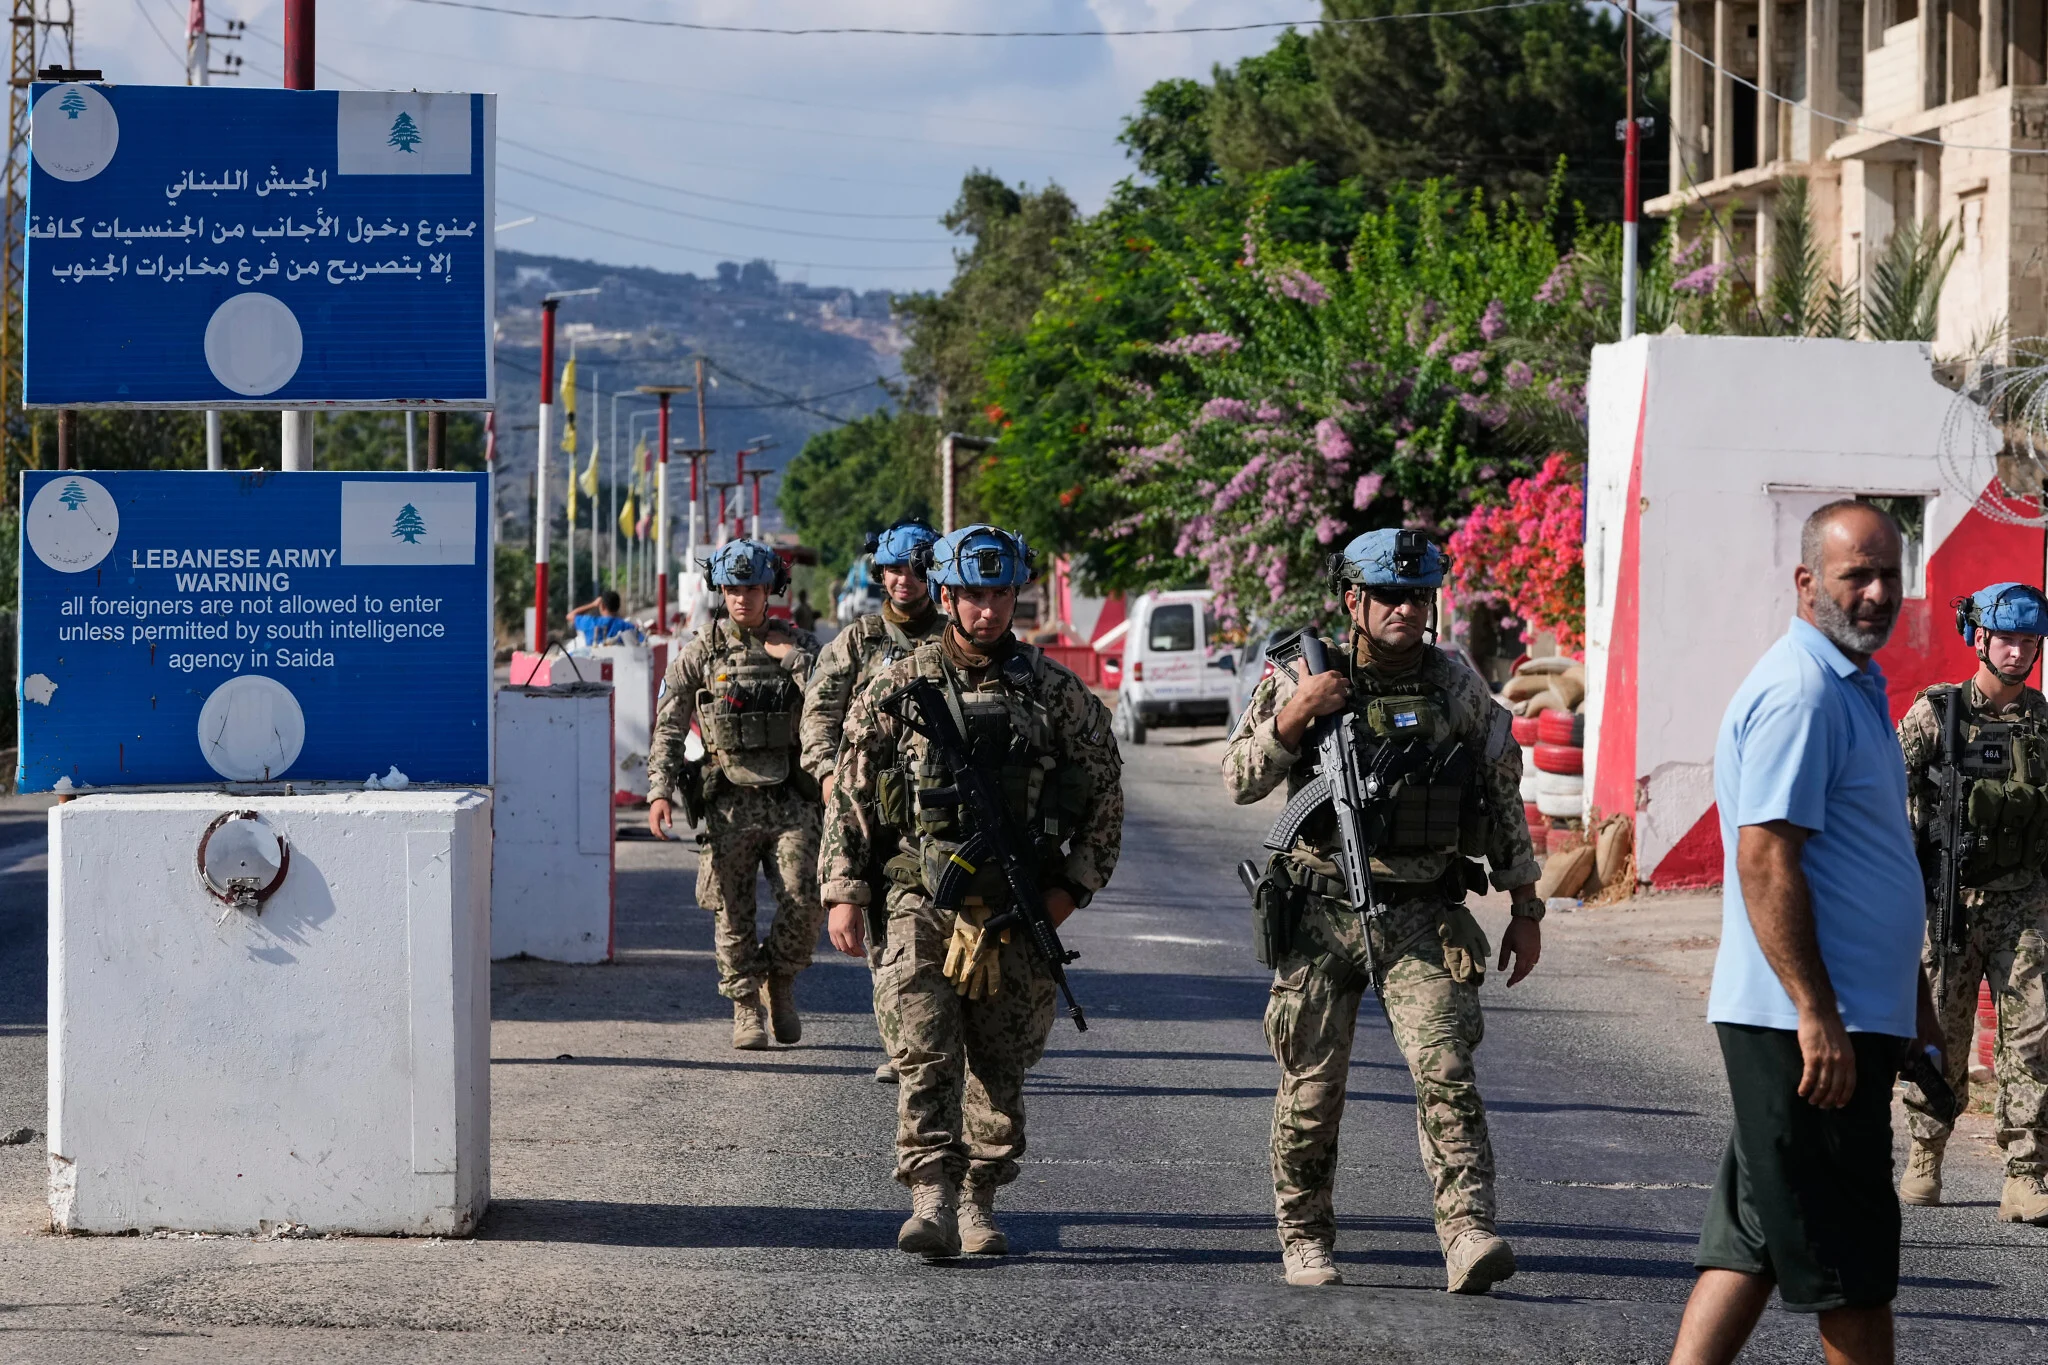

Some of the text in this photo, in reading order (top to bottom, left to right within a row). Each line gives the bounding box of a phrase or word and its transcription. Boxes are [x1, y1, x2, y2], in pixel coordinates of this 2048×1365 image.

[165, 165, 327, 207] الجيش اللبناني
[29, 207, 477, 247] ممنوع دخول الأجانب من الجنسيات كافة
[52, 252, 452, 285] إلا بتصريح من فرع مخابرات الجنوب
[132, 548, 337, 569] LEBANESE ARMY
[175, 573, 290, 592] WARNING
[60, 594, 443, 620] all foreigners are not allowed to enter
[59, 619, 445, 645] unless permitted by south intelligence
[168, 648, 334, 673] agency in Saida
